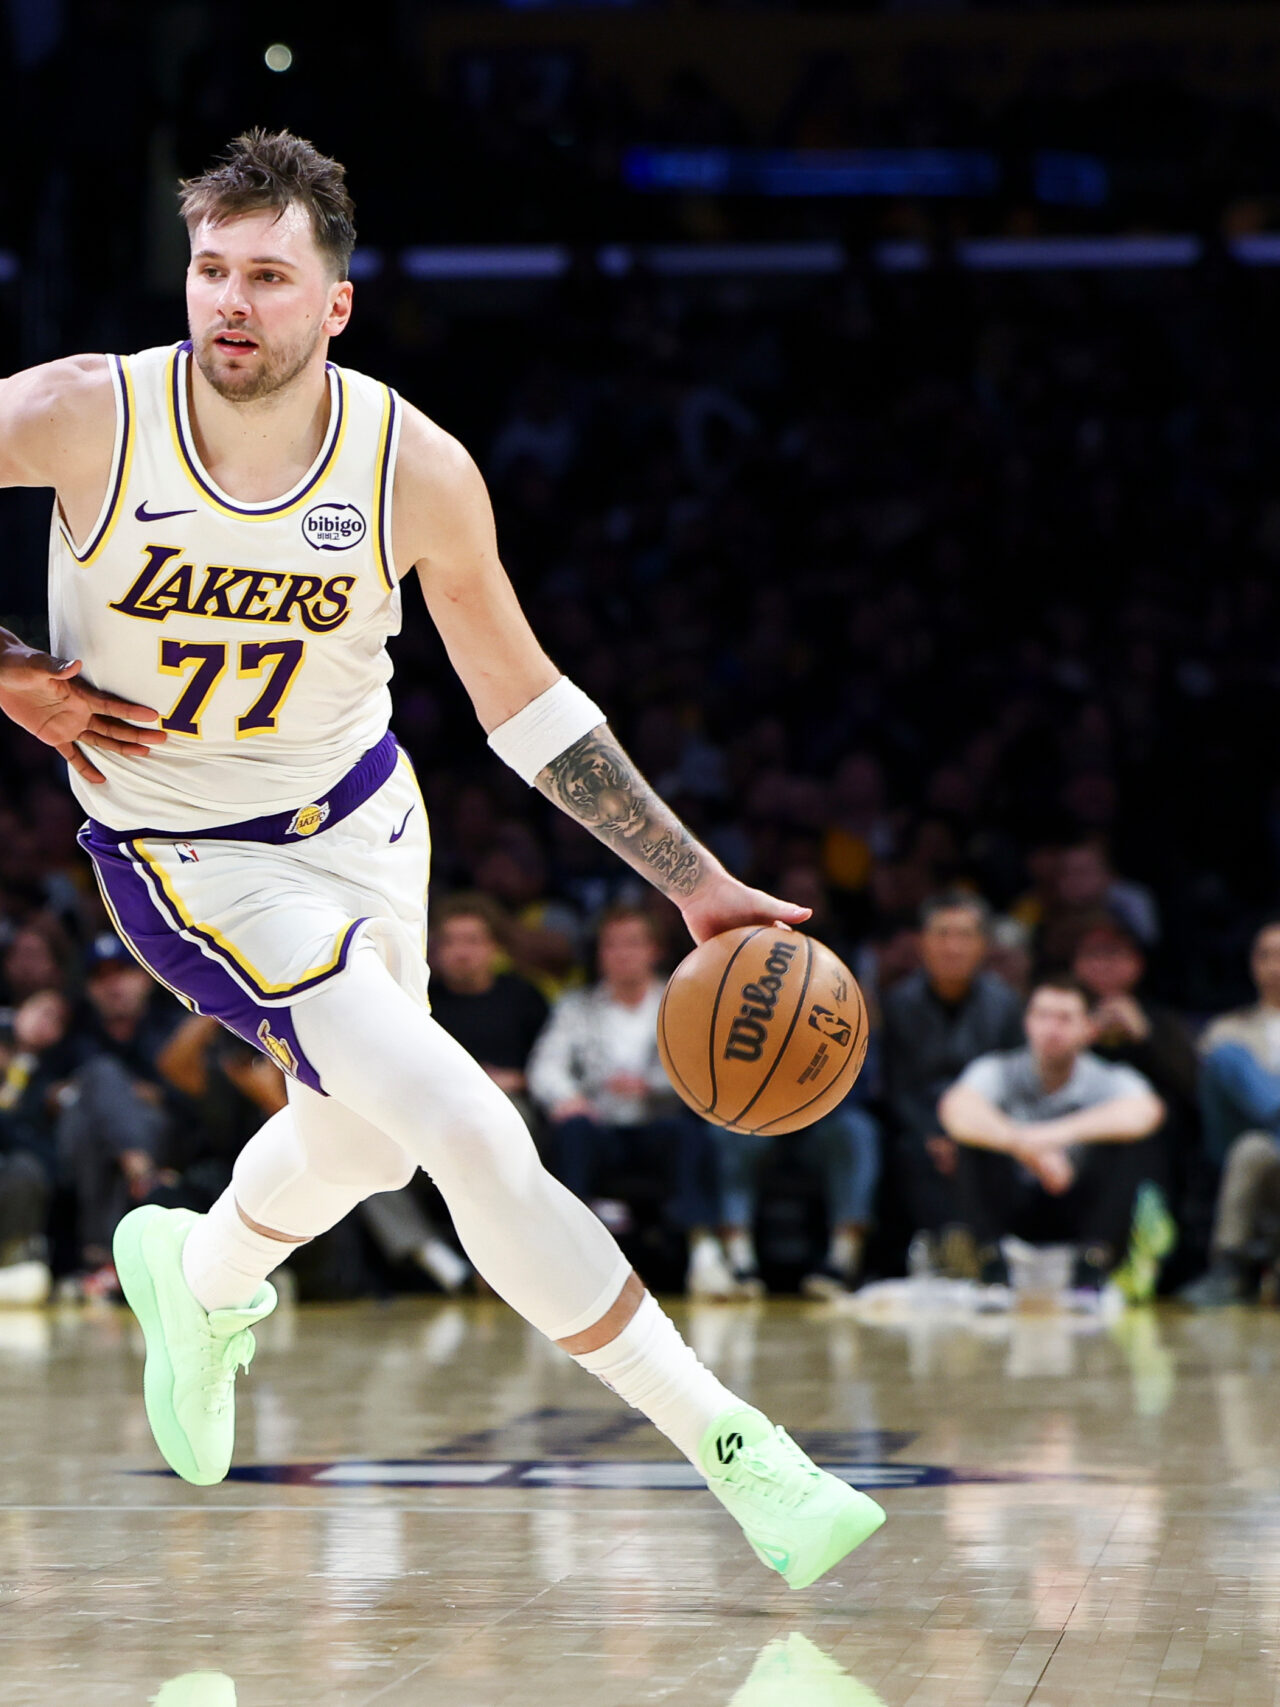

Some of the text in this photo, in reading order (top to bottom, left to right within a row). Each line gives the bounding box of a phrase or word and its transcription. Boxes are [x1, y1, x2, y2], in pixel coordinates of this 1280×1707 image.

[308, 516, 362, 537] bibigo
[317, 532, 340, 541] 비비고
[106, 543, 359, 635] LAKERS
[157, 637, 307, 741] 77
[723, 941, 799, 1063] Wilson
